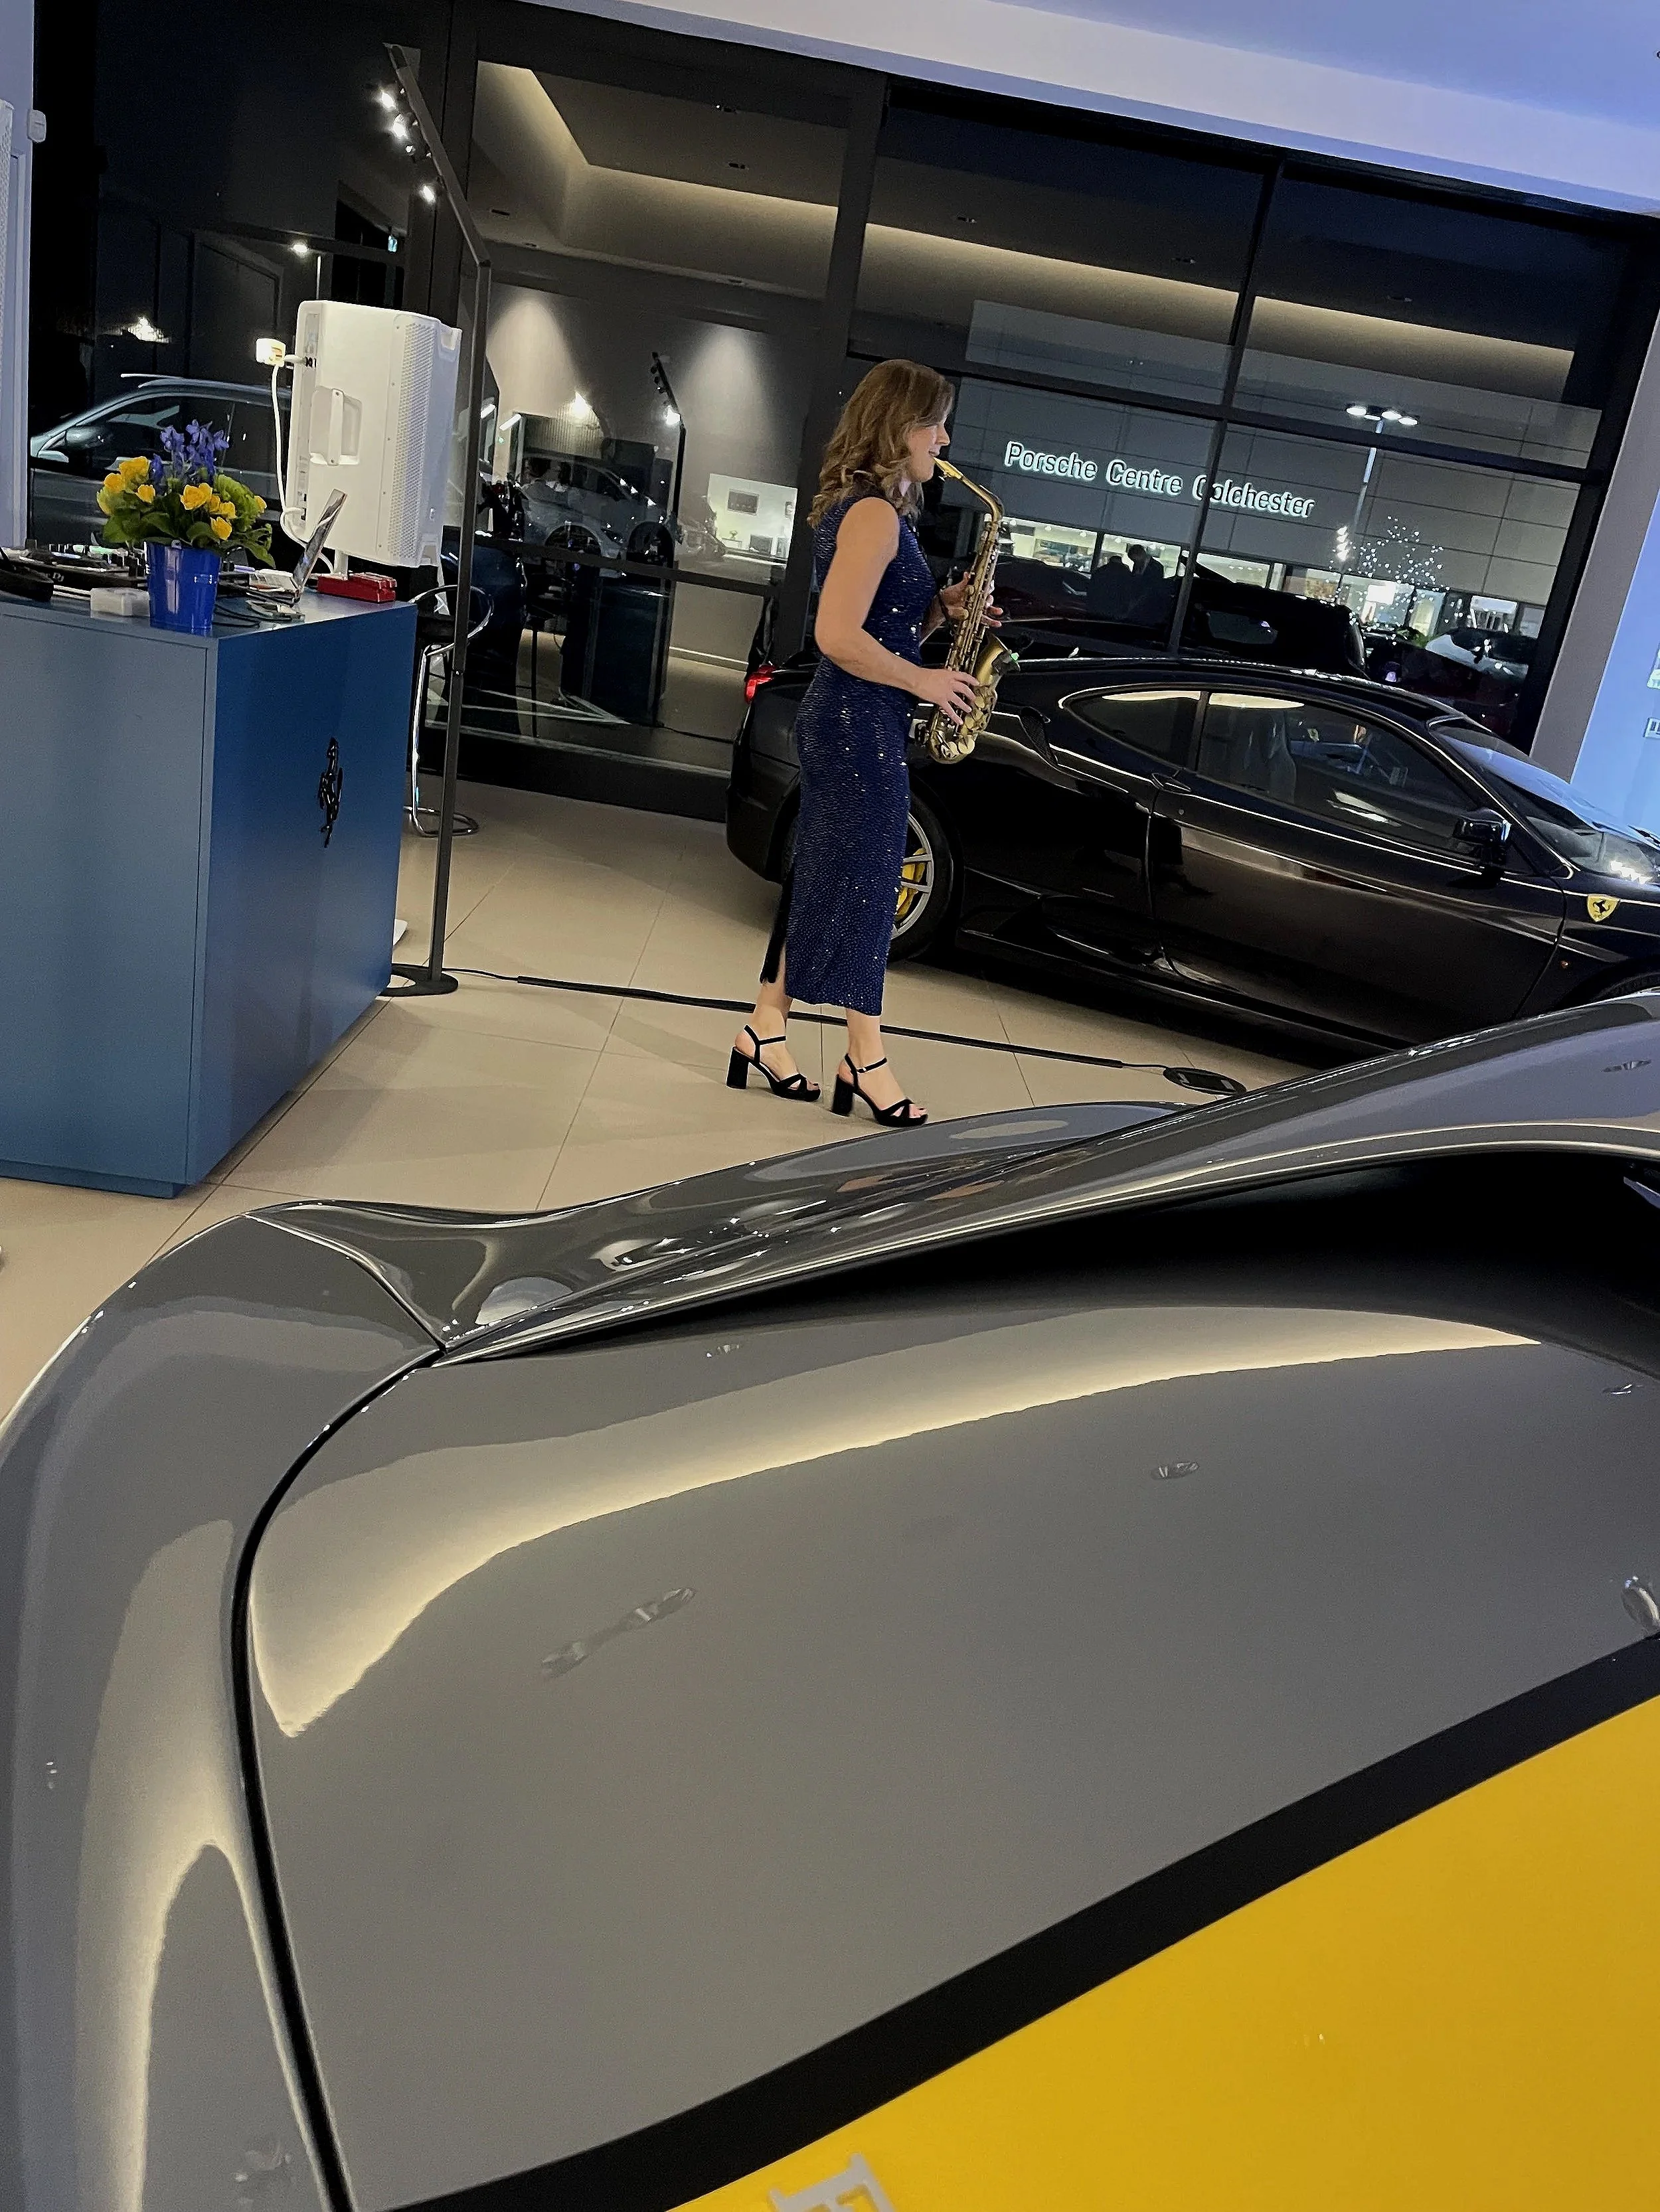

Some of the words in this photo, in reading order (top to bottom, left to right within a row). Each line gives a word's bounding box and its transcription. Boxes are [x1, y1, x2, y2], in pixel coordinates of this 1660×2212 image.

[1004, 441, 1098, 481] Porsche
[1106, 459, 1184, 496] Centre
[1192, 474, 1315, 518] Colchester
